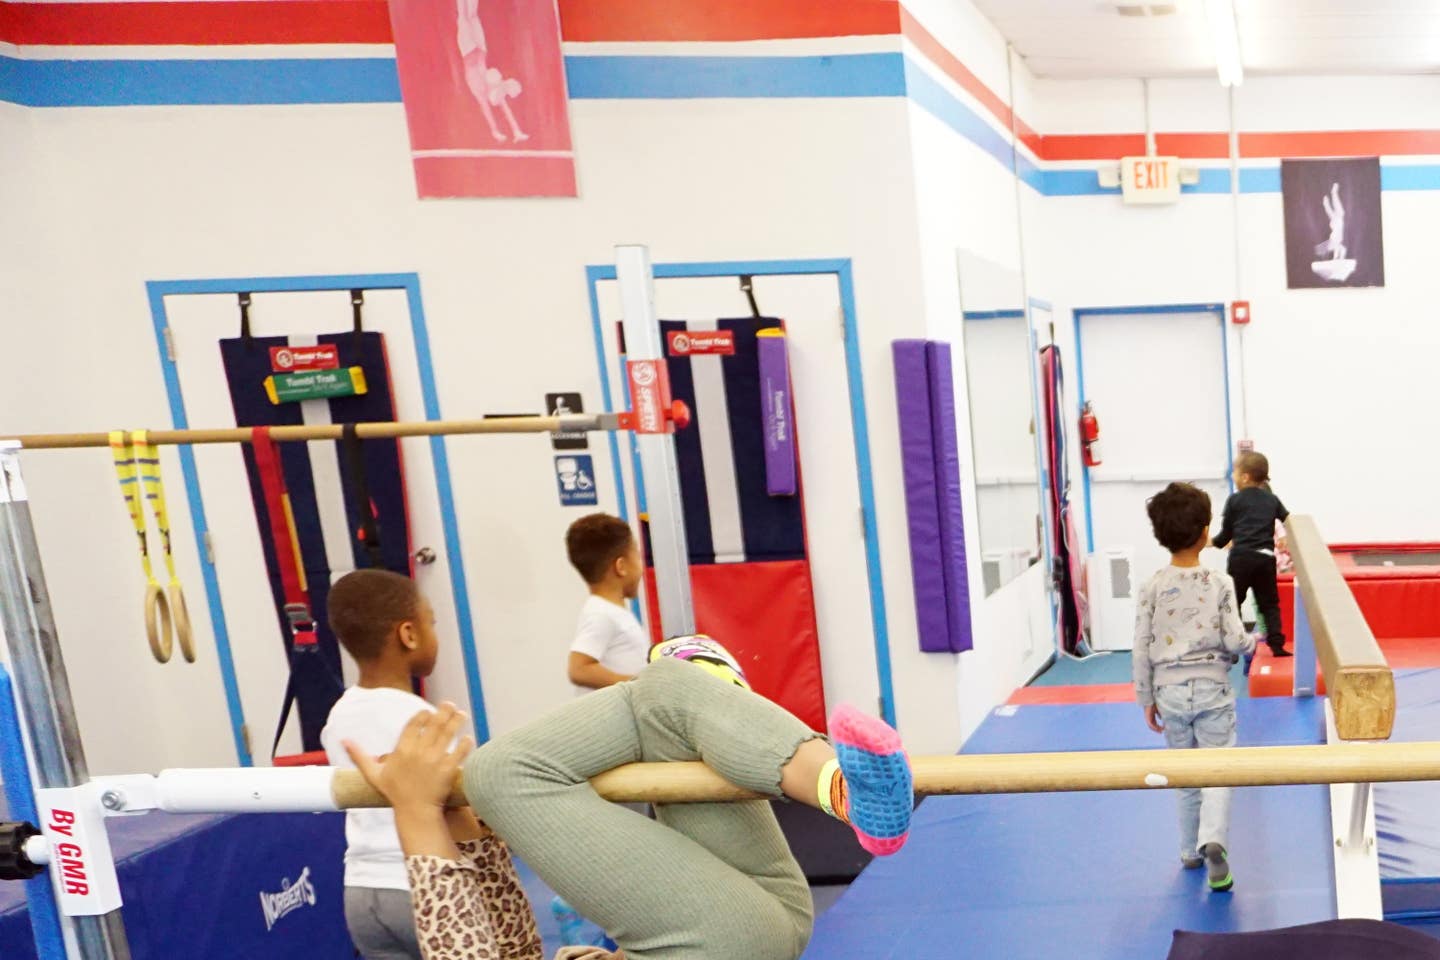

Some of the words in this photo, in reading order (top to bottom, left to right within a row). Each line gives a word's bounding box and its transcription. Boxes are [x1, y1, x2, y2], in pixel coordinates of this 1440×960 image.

[1133, 161, 1169, 189] EXIT
[48, 808, 76, 837] By
[58, 842, 90, 896] GMR
